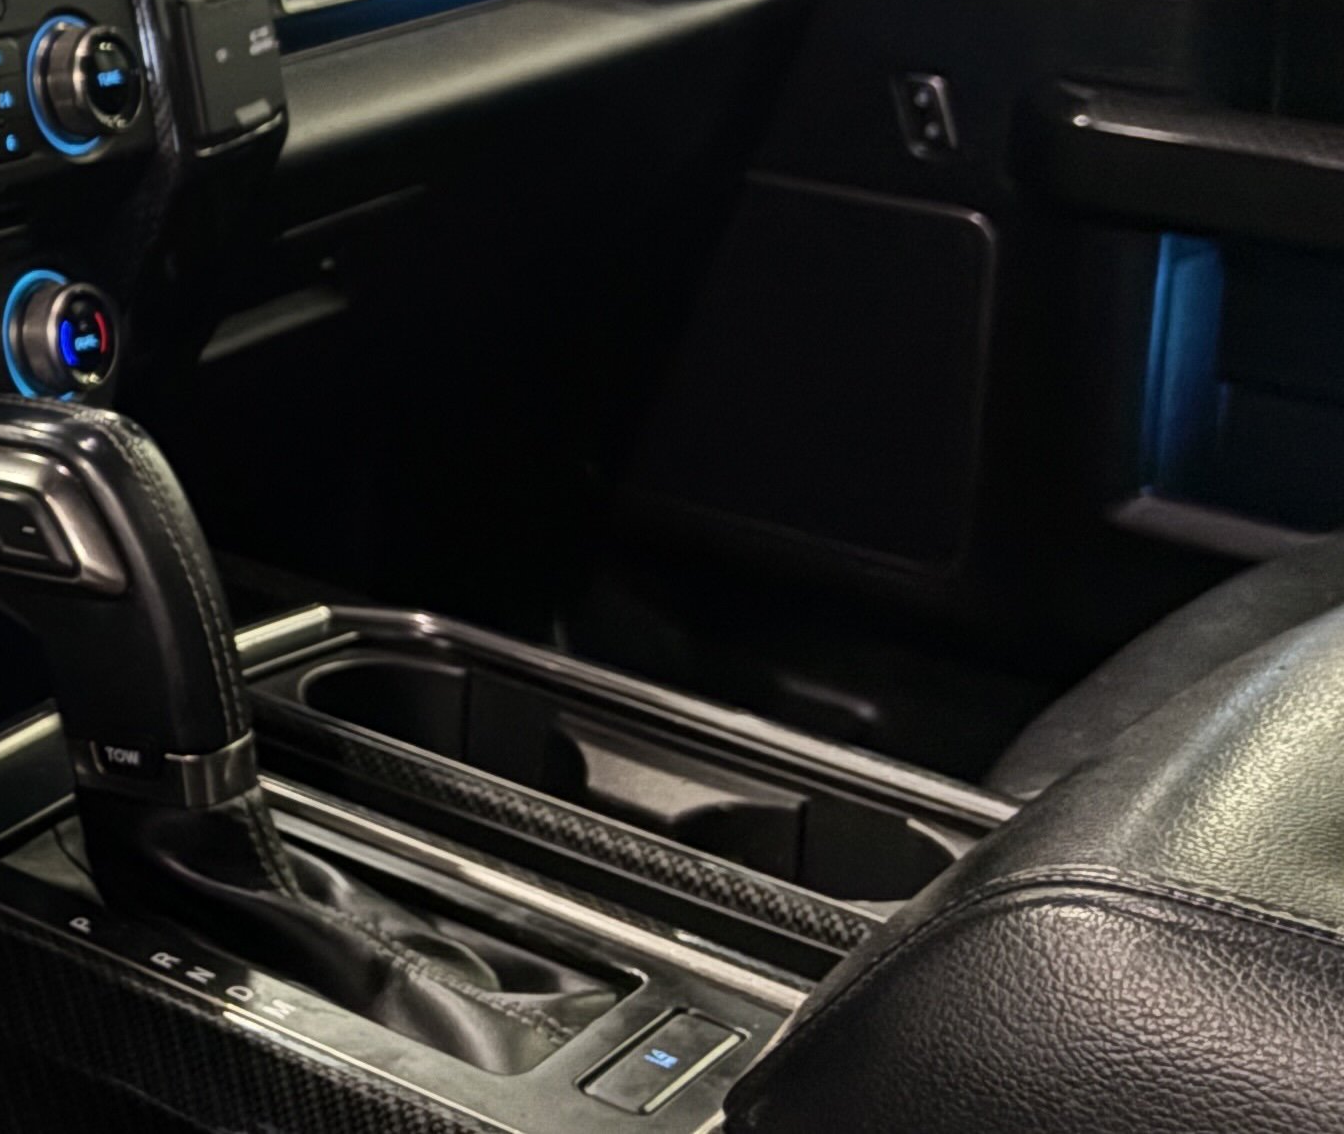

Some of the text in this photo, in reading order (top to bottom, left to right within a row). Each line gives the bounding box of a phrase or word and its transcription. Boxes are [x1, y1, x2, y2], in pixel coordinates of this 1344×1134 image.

[106, 747, 140, 764] TOW
[69, 917, 92, 934] P
[150, 952, 181, 970] R
[185, 966, 216, 984] N
[226, 984, 254, 1002] D
[261, 999, 297, 1020] M
